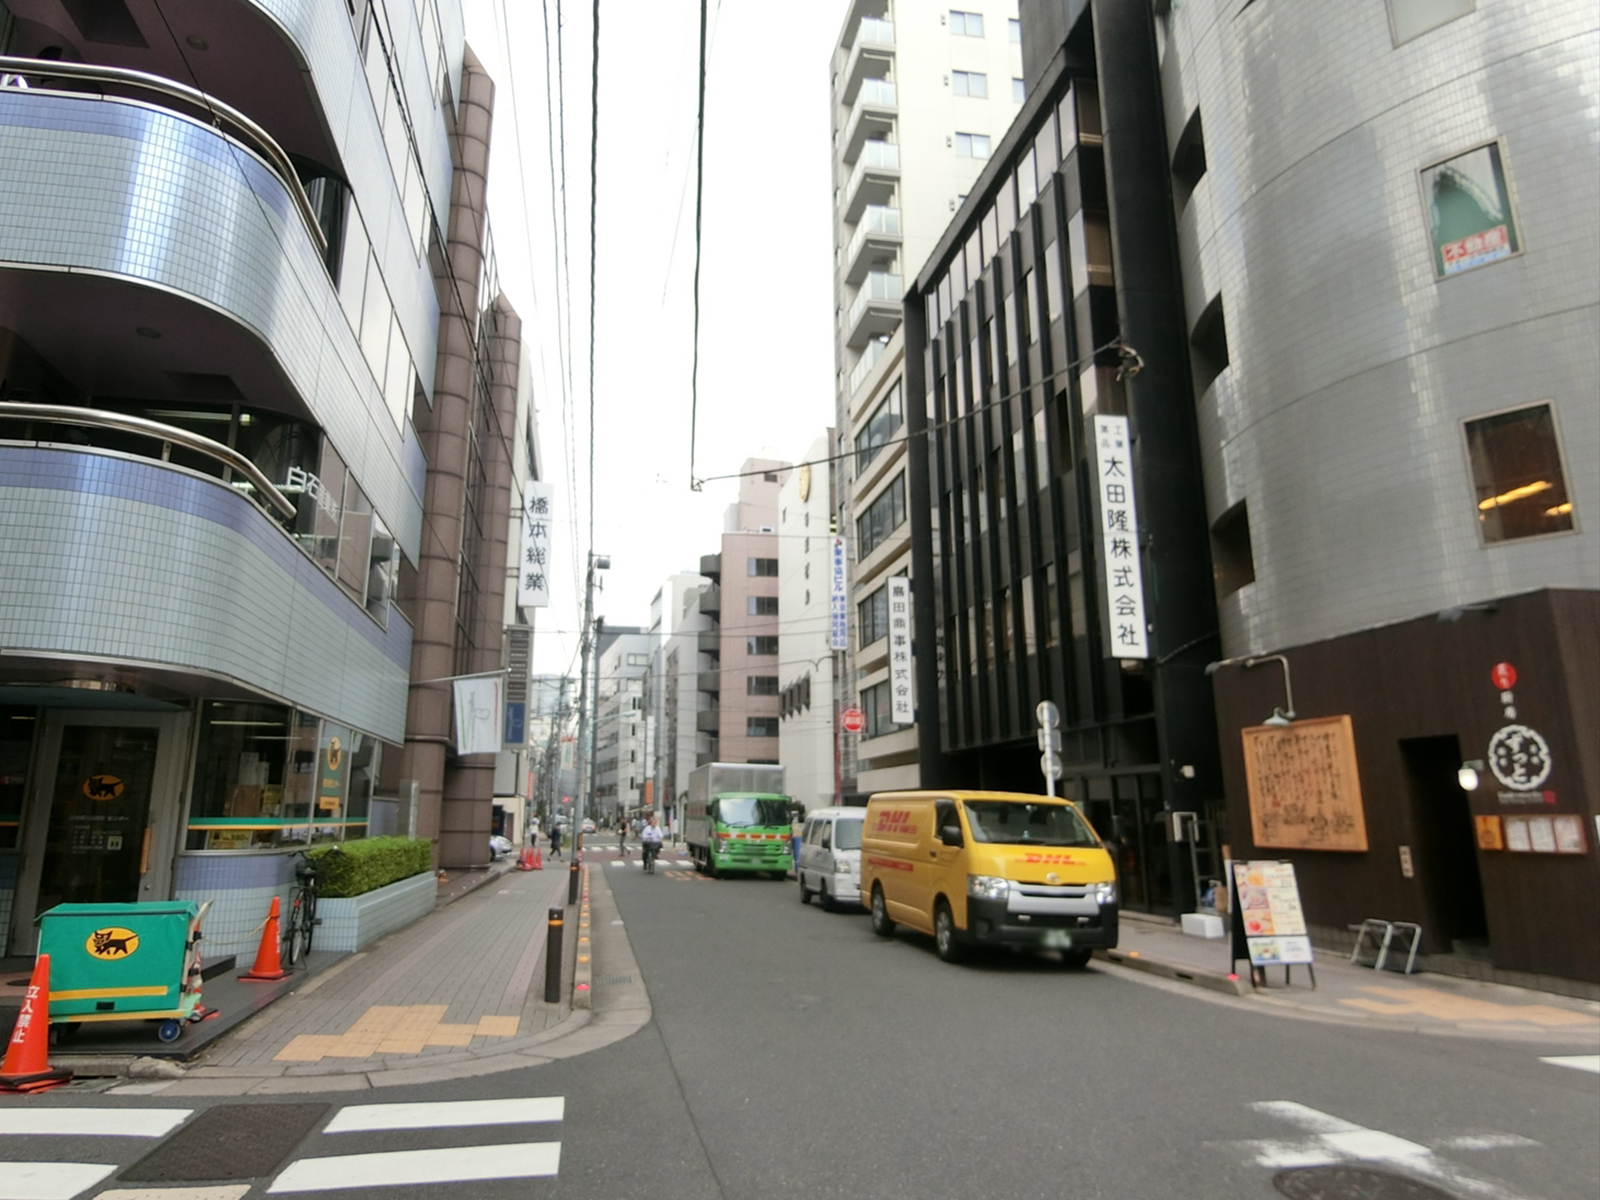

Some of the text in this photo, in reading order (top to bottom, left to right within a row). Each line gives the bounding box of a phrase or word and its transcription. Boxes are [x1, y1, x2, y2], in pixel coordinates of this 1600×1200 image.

[525, 496, 549, 591] 橋本総業
[1104, 456, 1139, 646] 太田隆株式会社
[878, 811, 911, 833] DHL
[1025, 853, 1076, 865] DHL
[12, 986, 40, 1043] 立入禁止
